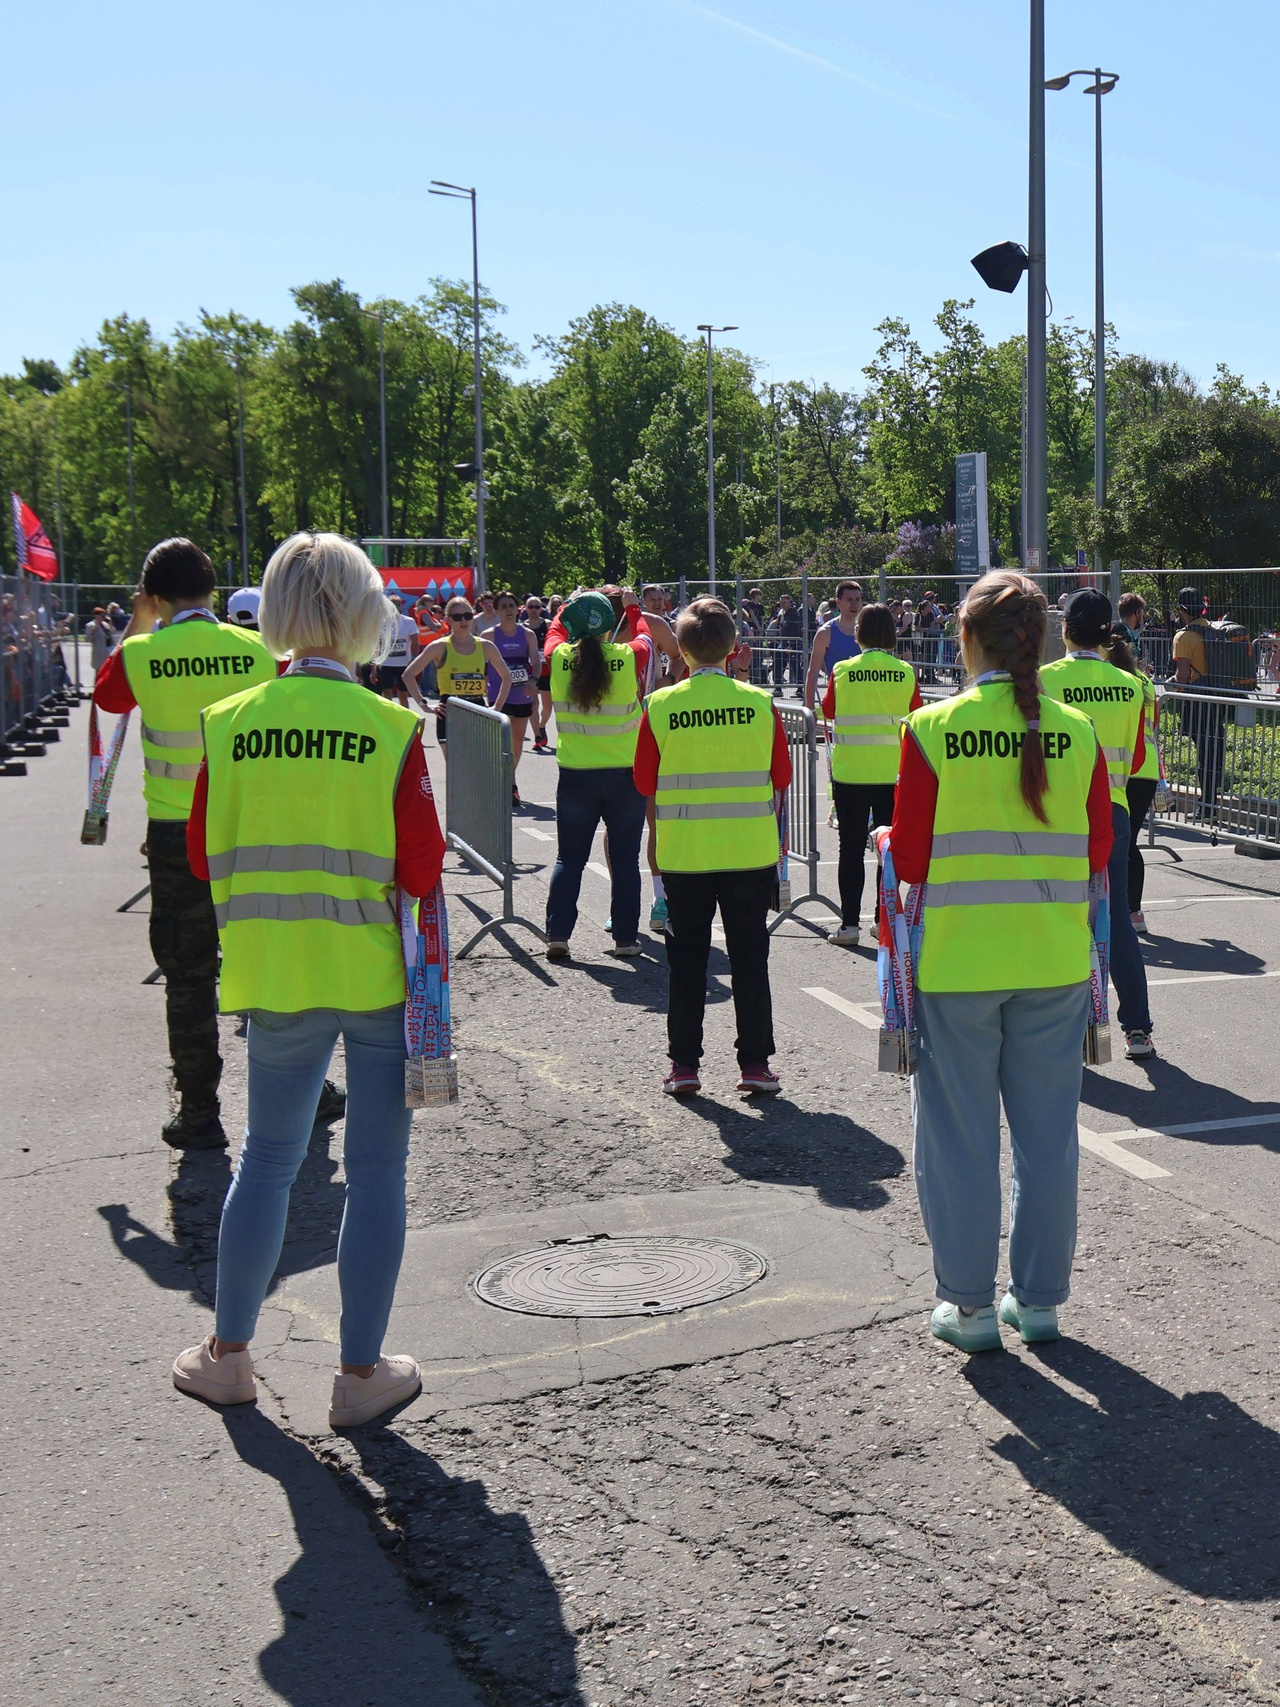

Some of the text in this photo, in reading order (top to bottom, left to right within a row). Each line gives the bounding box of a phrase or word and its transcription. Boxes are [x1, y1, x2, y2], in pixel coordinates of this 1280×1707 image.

[149, 655, 254, 679] ВОЛОНТЕР
[562, 659, 624, 671] ВОЕР
[510, 670, 525, 679] 003
[848, 670, 906, 682] ВОЛОНТЕР
[455, 681, 482, 690] 5723
[1062, 686, 1134, 704] ВОЛОНТЕР
[669, 707, 755, 730] ВОЛОНТЕР
[232, 729, 376, 764] ВОЛОНТЕР
[945, 730, 1071, 760] ВОЛОНЕР
